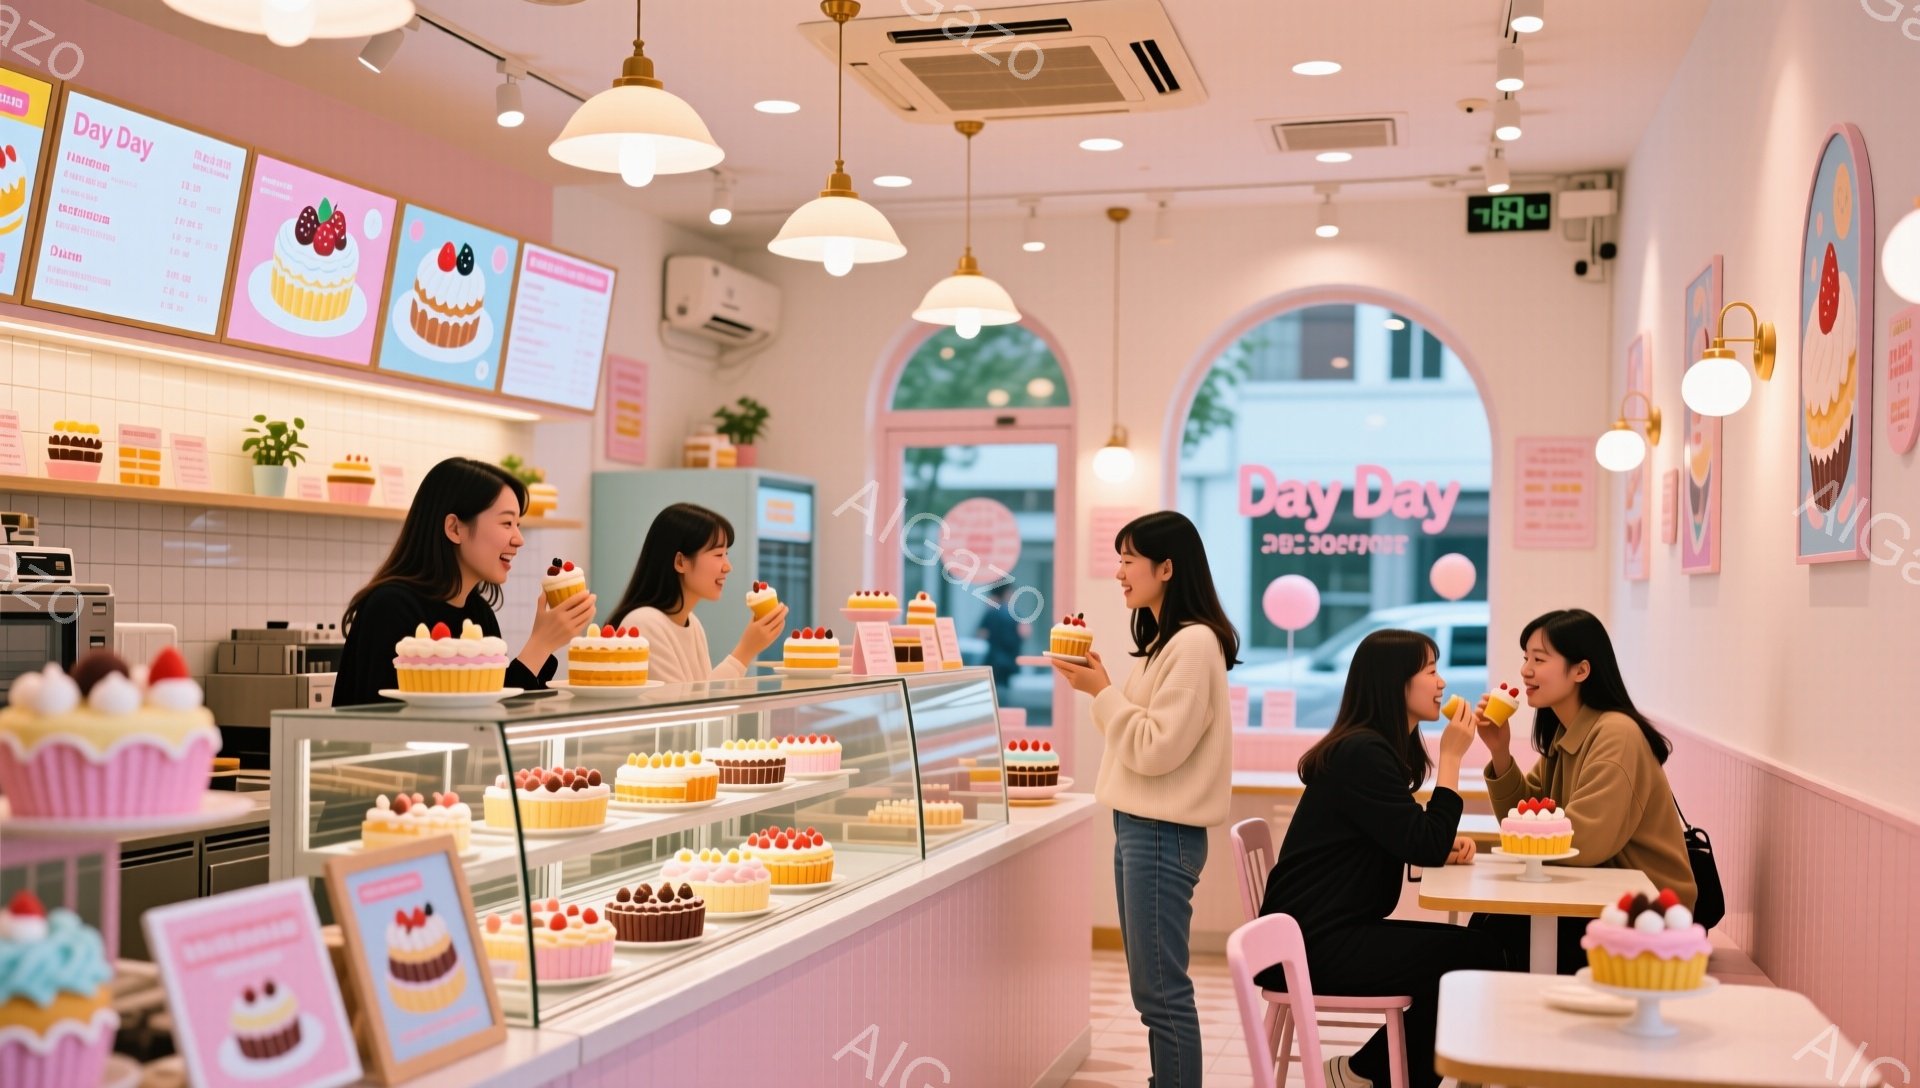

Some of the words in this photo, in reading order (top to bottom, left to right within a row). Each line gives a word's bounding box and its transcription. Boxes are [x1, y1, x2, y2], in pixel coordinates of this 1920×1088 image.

[73, 111, 113, 149] Day
[116, 126, 154, 162] Day
[1238, 464, 1343, 533] Day
[1353, 464, 1461, 535] Day
